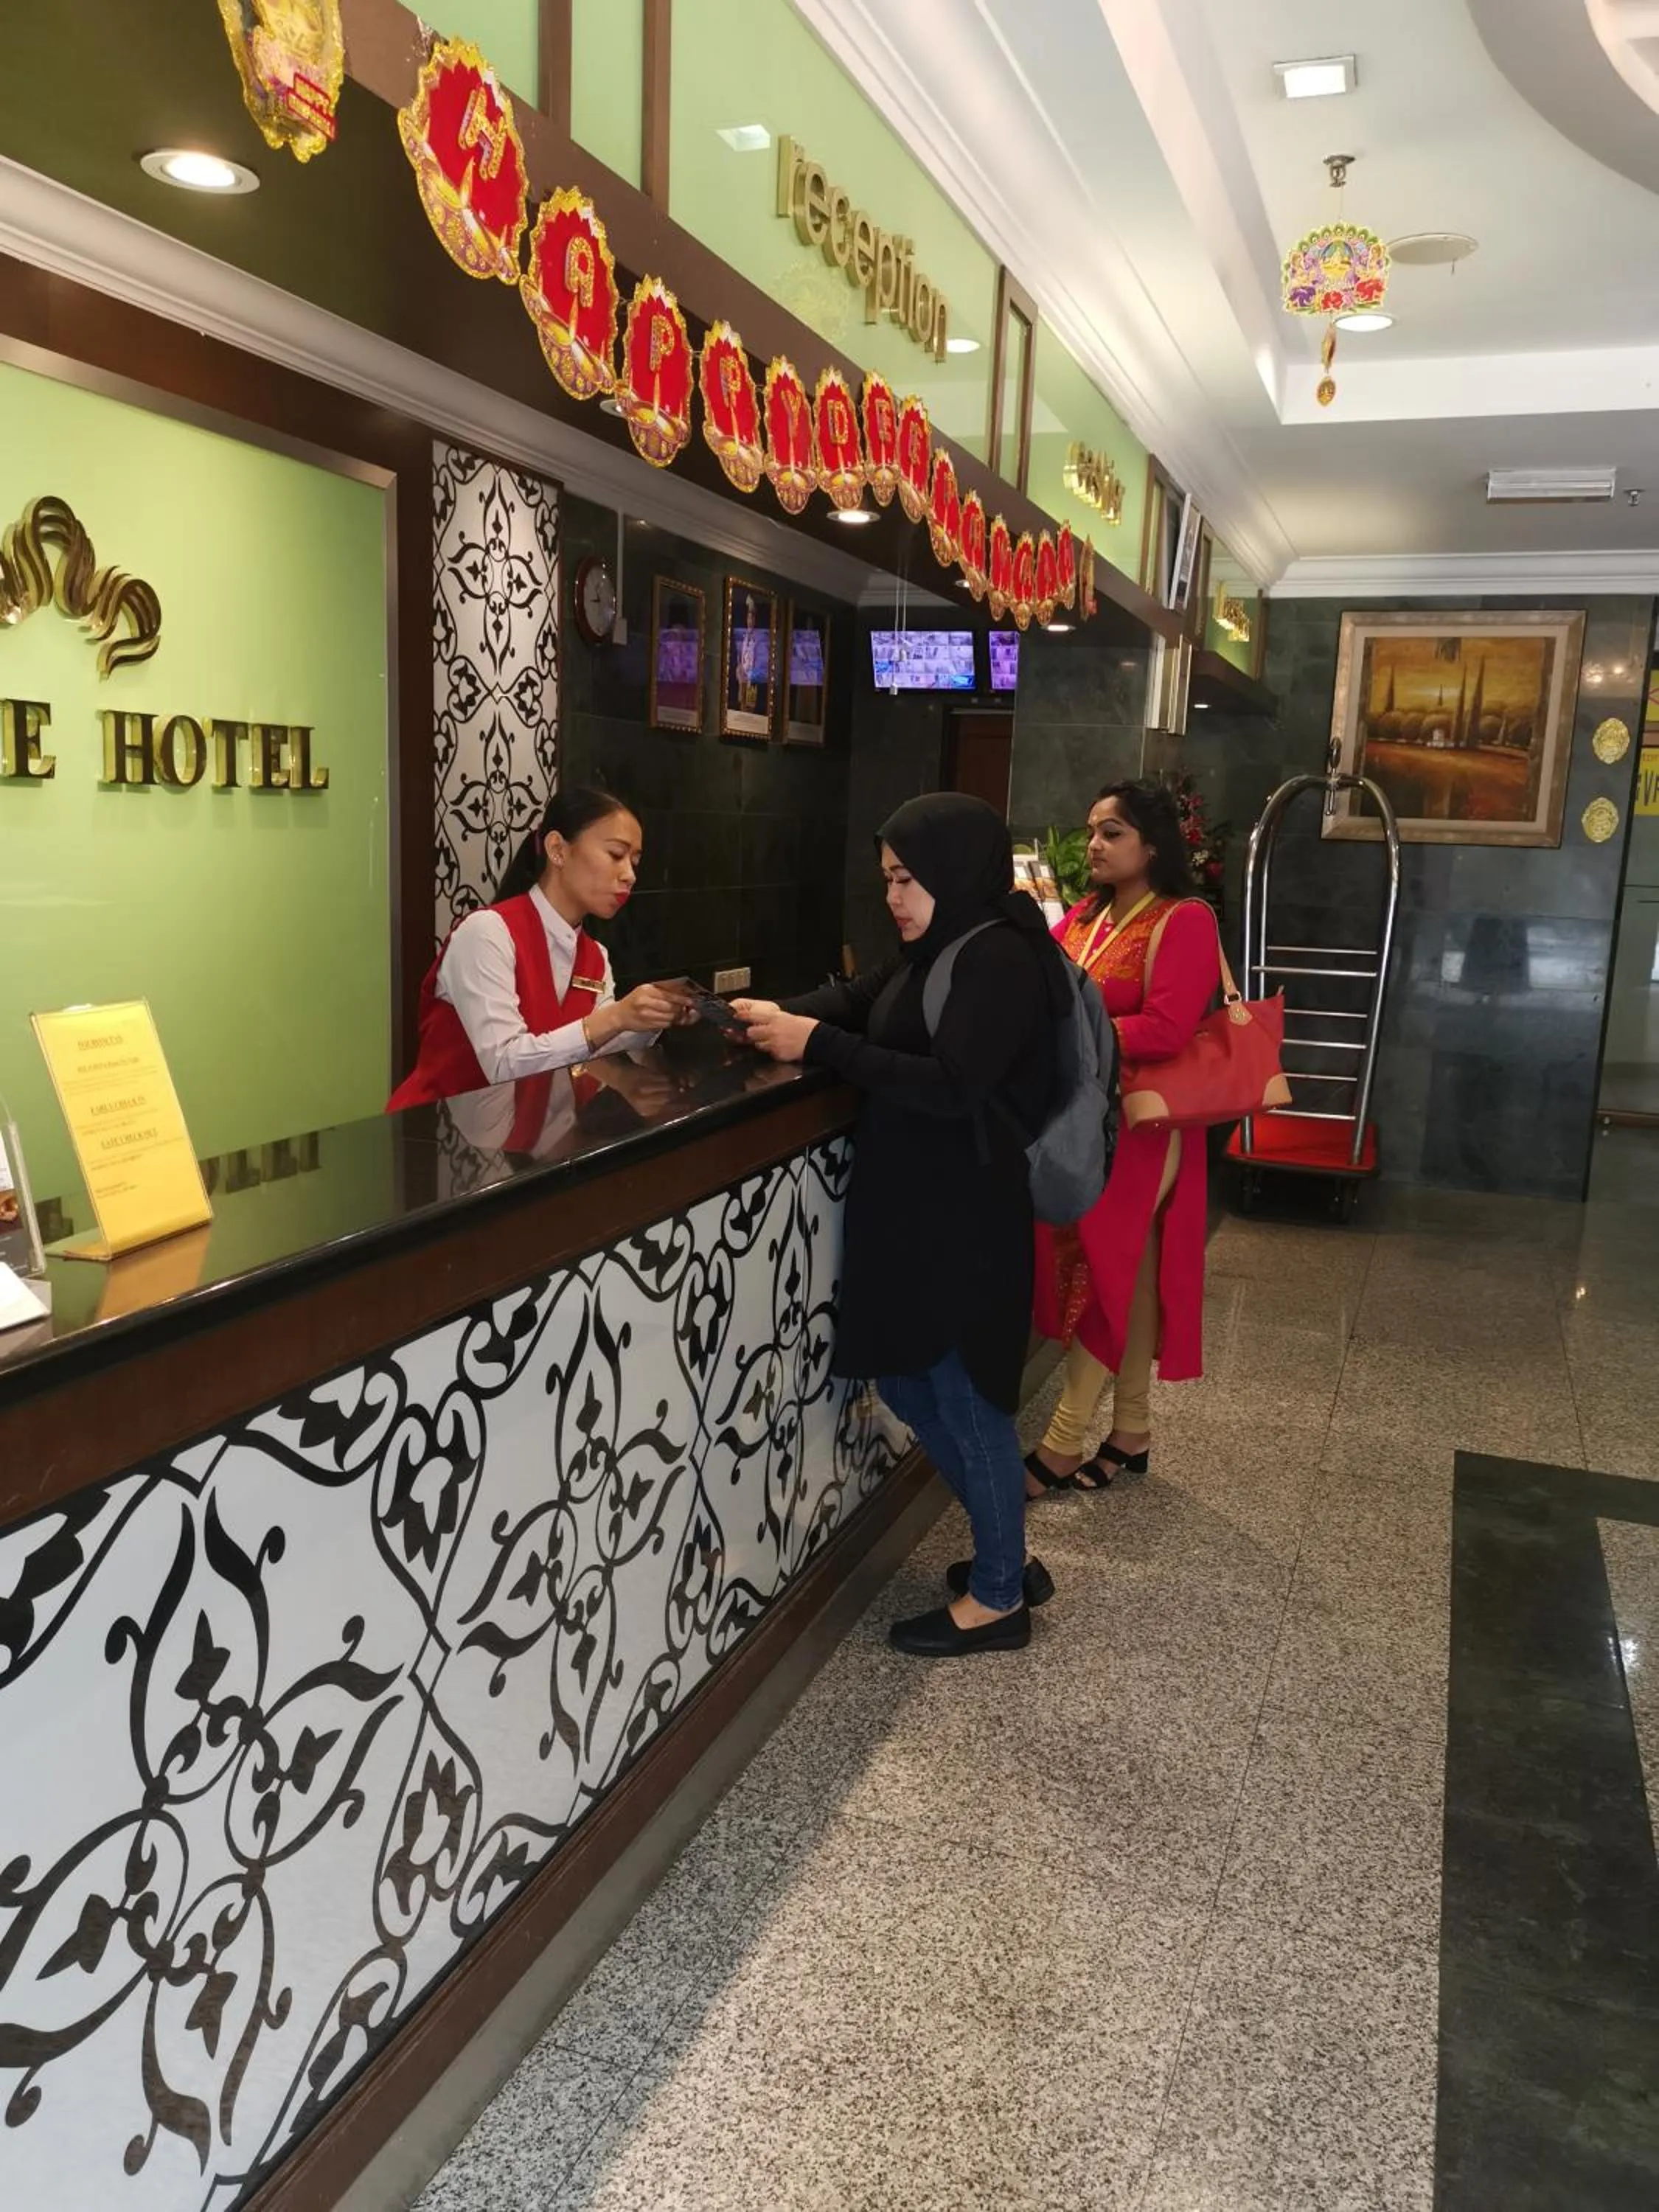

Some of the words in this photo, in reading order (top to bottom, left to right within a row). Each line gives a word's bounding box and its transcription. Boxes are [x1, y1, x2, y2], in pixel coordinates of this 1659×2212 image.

[459, 87, 803, 437] HAPPY
[776, 133, 948, 364] reception
[97, 708, 330, 790] HOTEL
